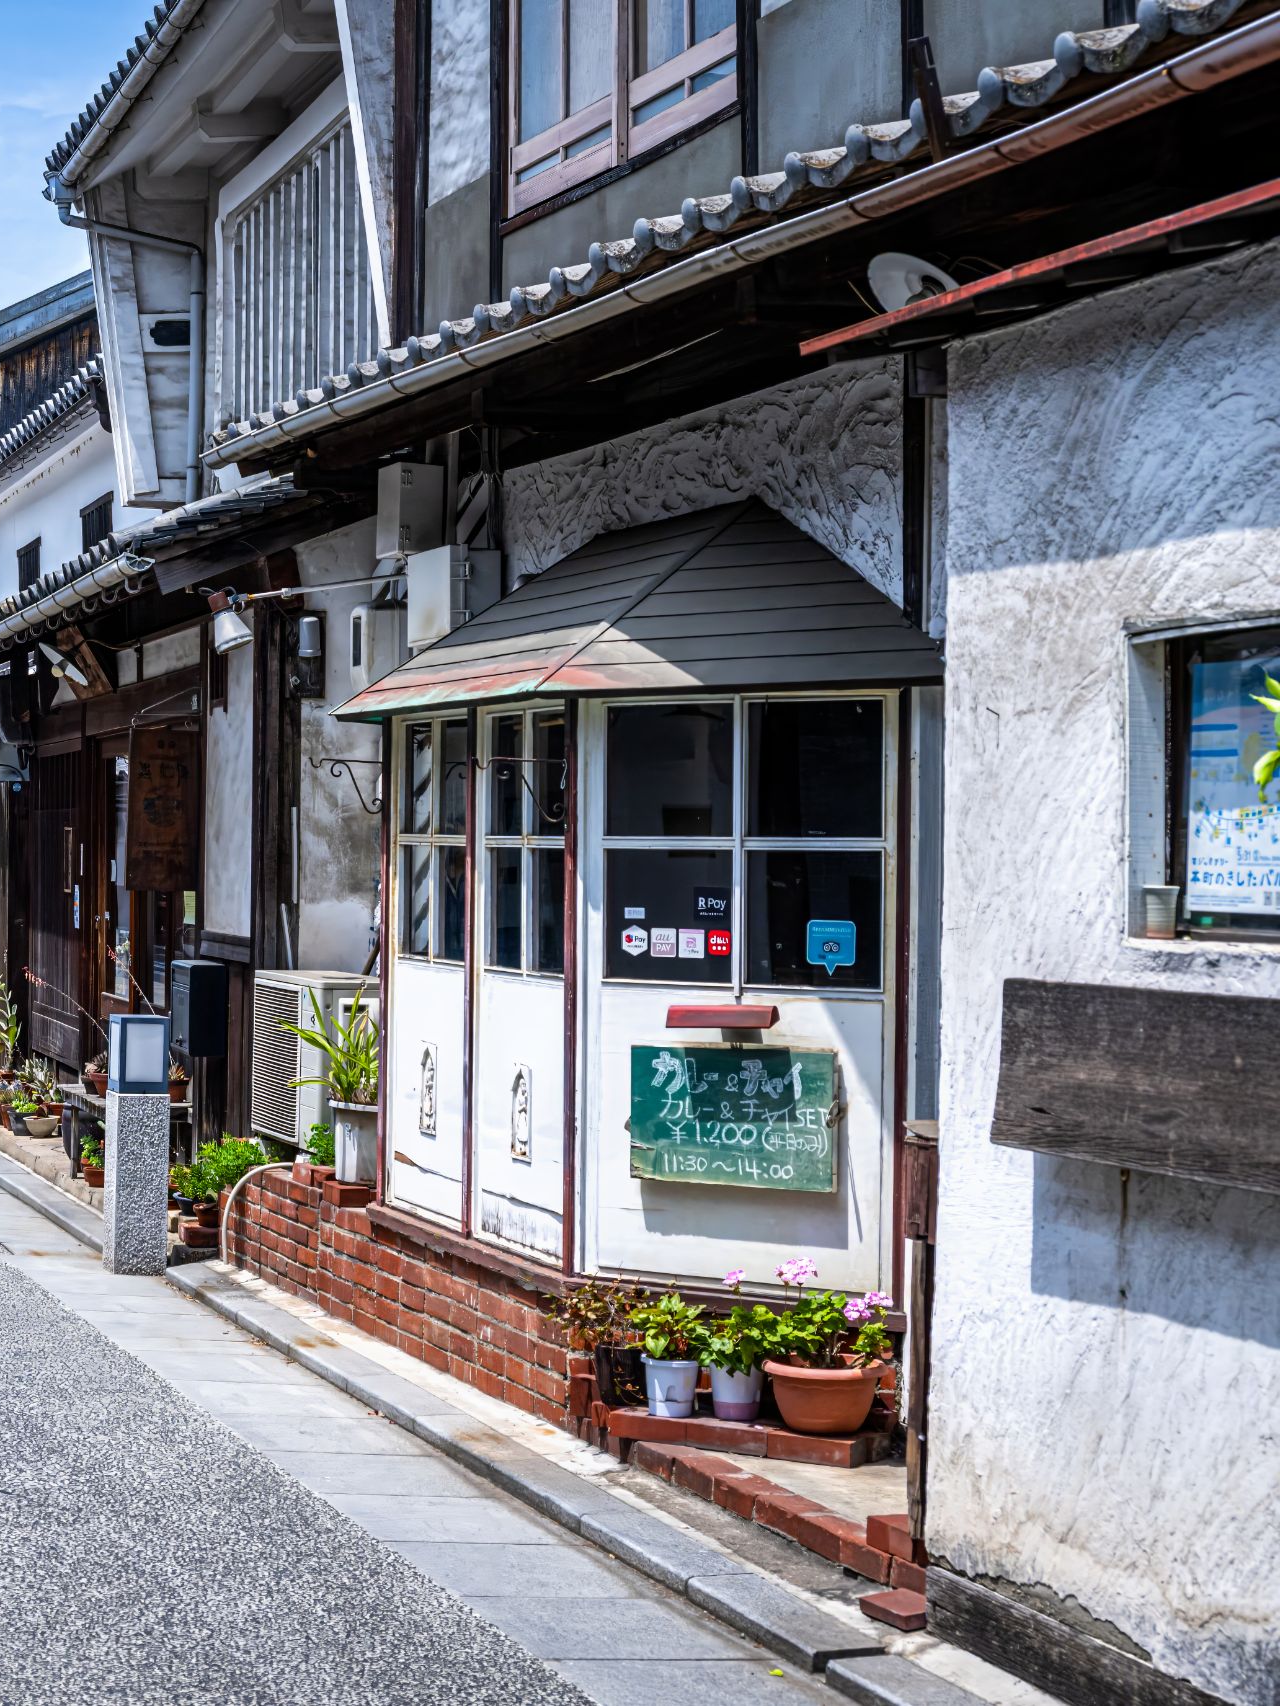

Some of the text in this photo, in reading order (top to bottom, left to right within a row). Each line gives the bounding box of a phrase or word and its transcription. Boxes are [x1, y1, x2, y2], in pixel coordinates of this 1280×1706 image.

[708, 898, 727, 911] Pay
[634, 935, 646, 943] Pay
[655, 934, 672, 942] au
[656, 943, 672, 953] PAY
